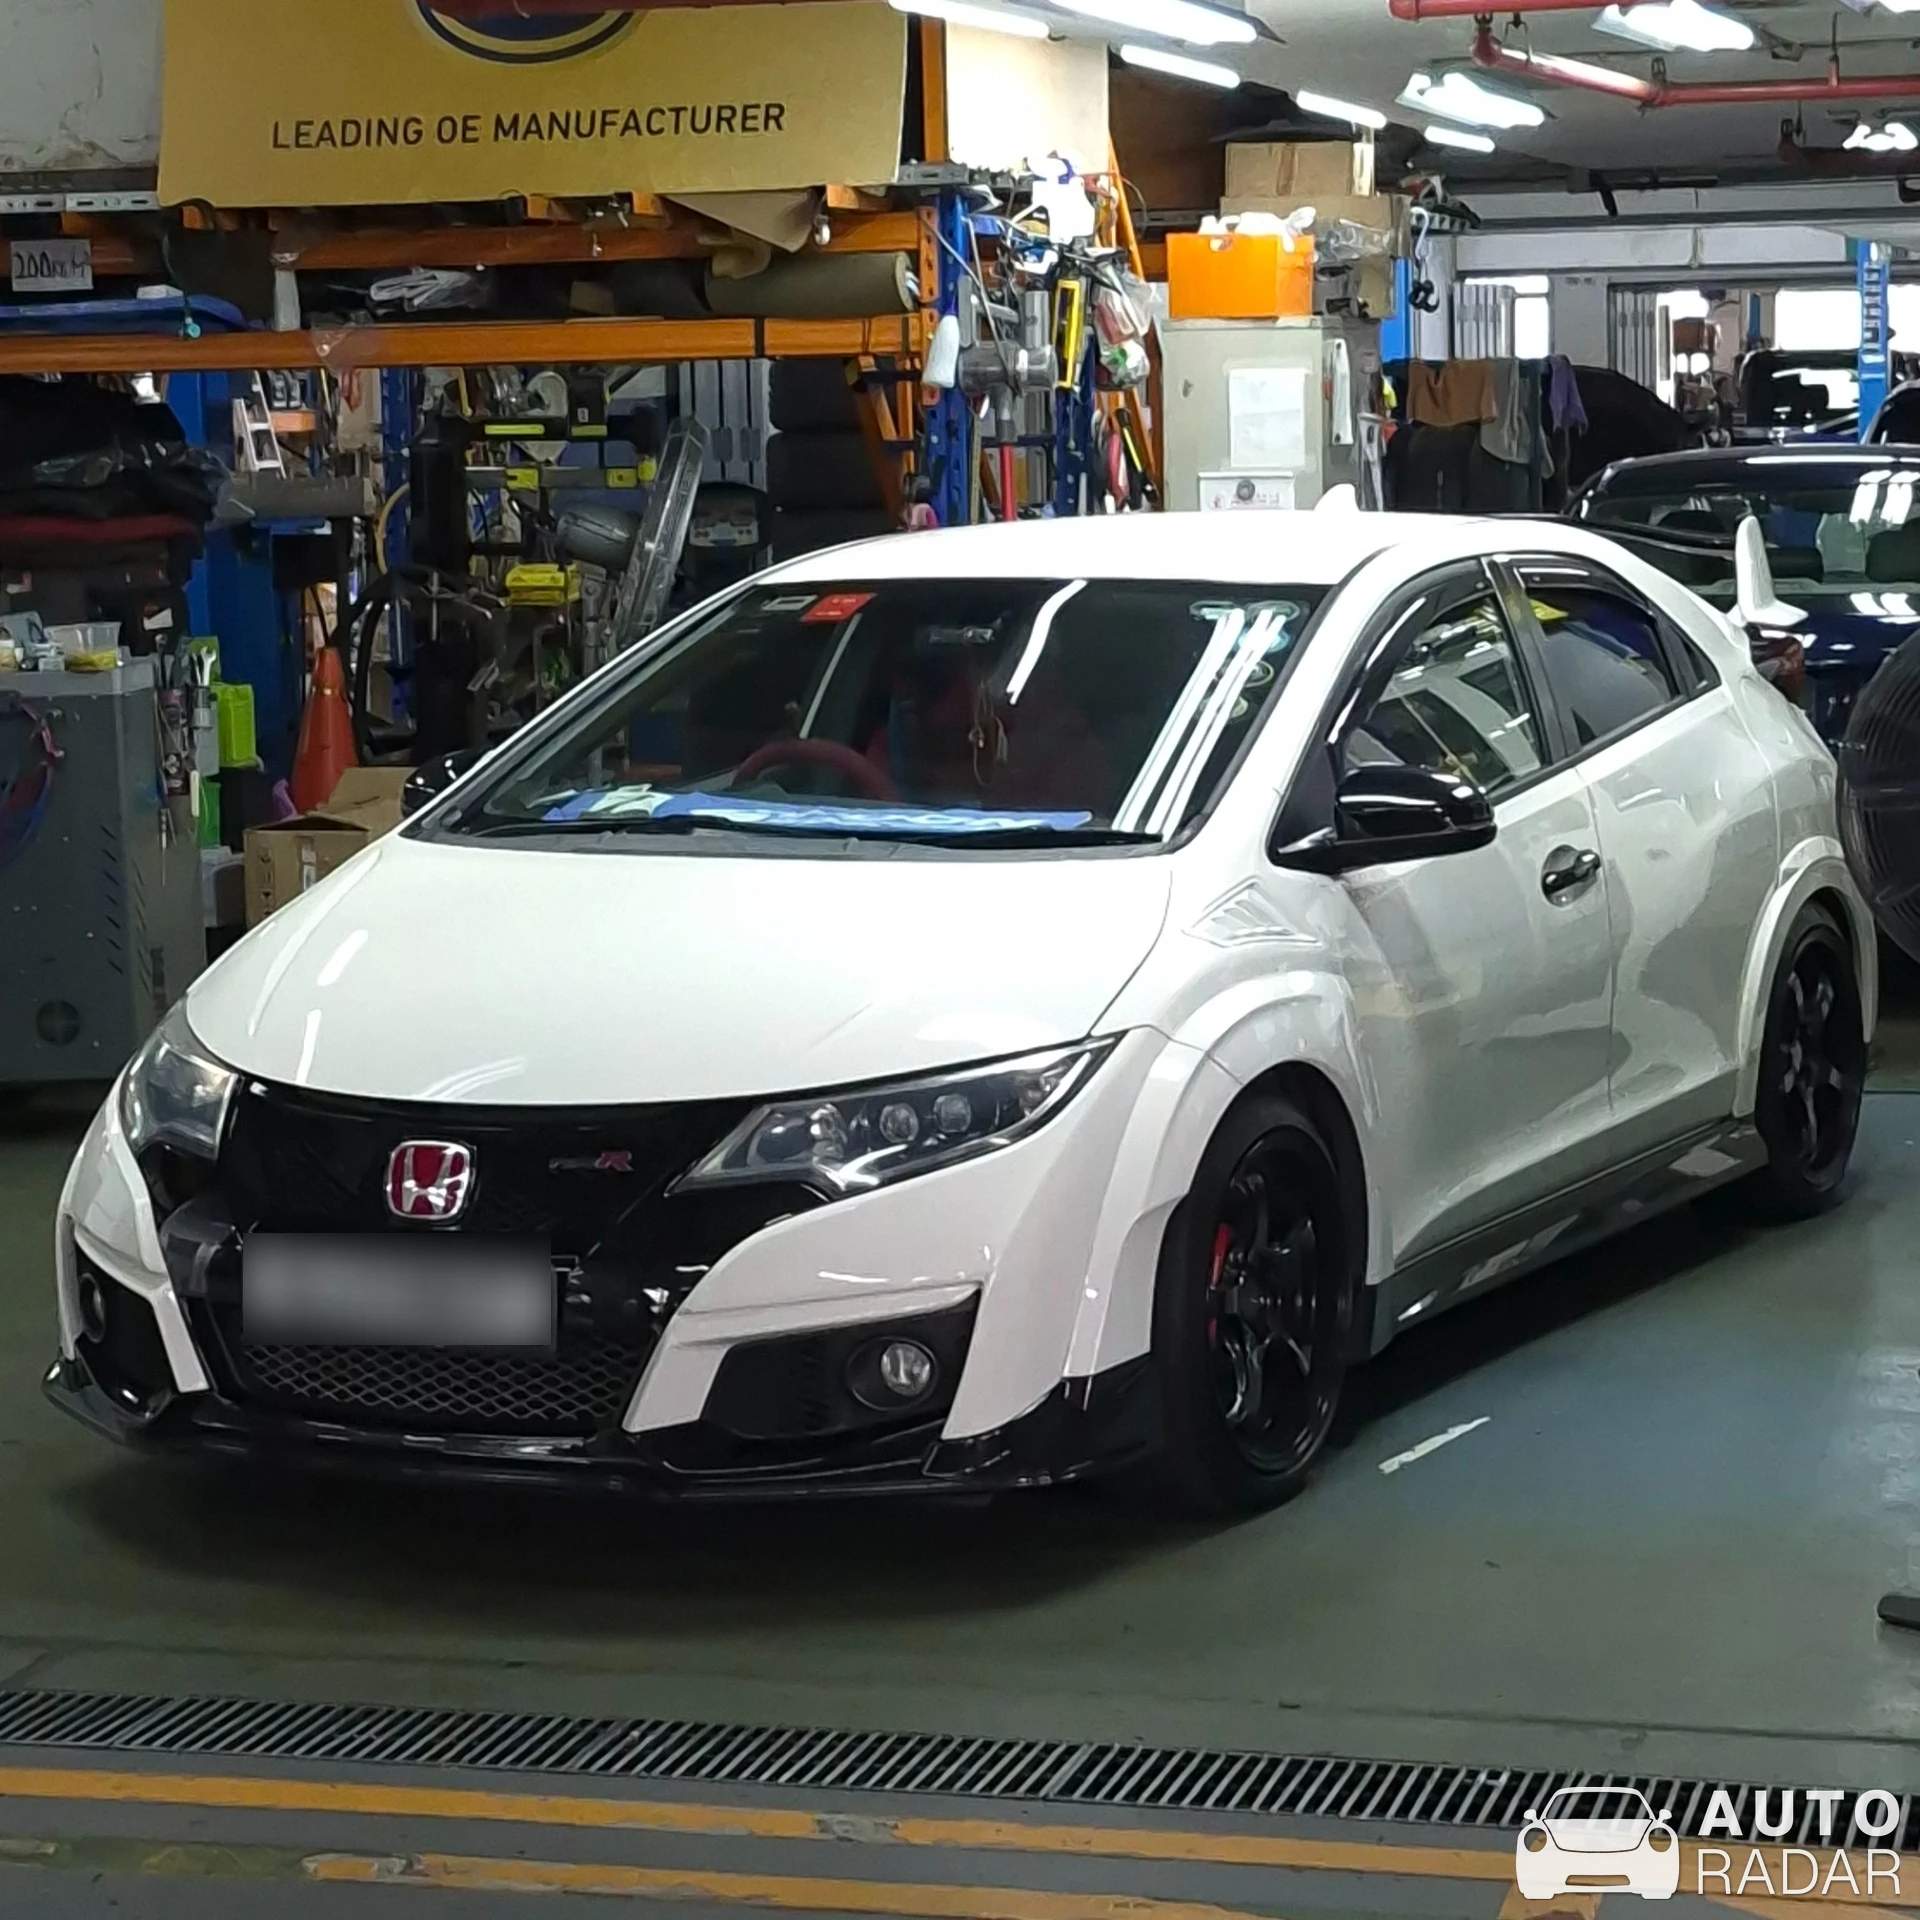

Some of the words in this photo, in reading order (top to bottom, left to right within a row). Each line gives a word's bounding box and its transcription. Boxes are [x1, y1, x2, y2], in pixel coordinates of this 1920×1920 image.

[272, 117, 424, 149] LEADING
[436, 114, 482, 144] OE
[493, 102, 786, 142] MANUFACTURER
